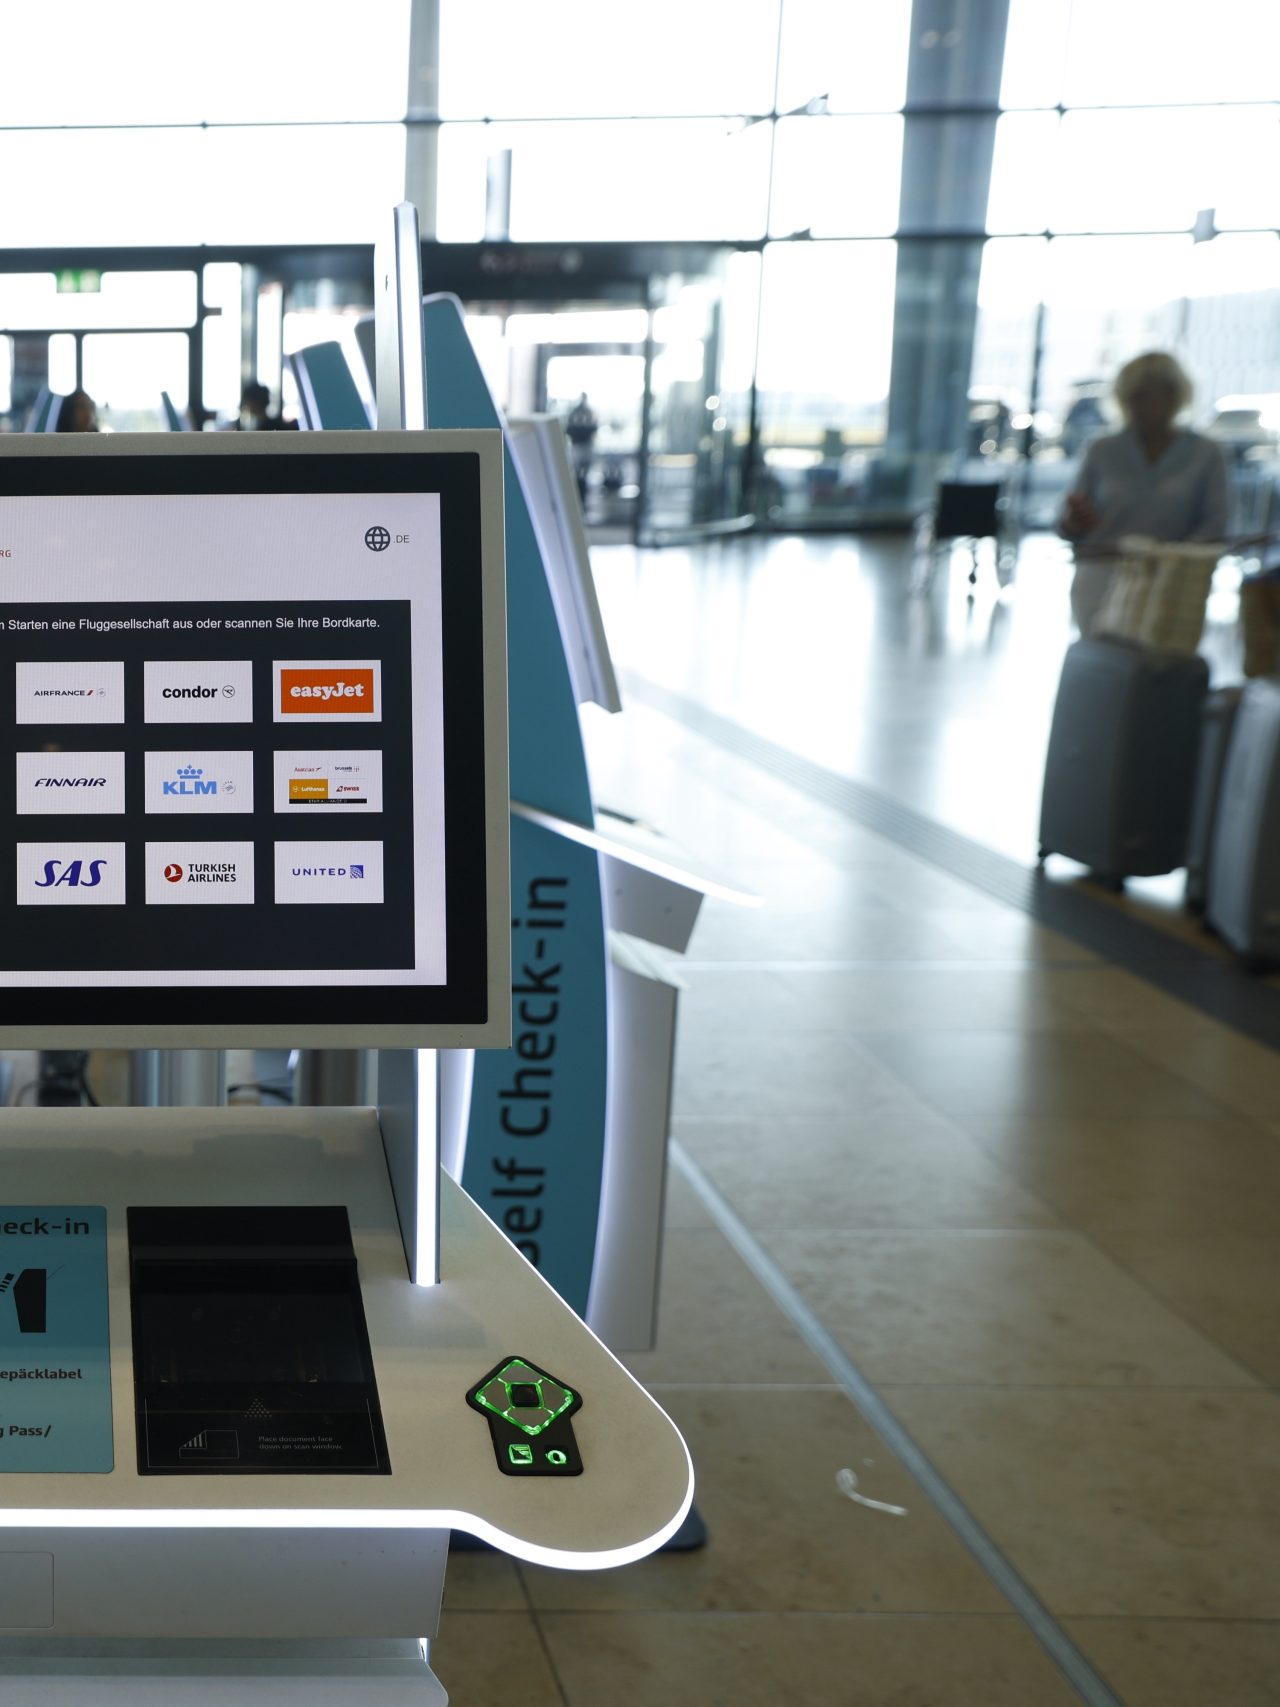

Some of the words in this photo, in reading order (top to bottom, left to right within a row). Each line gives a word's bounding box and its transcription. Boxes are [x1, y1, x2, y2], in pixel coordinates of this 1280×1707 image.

[8, 618, 49, 630] Starten
[52, 619, 76, 630] eine
[79, 617, 170, 632] Fluggesellschaft
[173, 619, 192, 629] aus
[196, 618, 221, 629] oder
[225, 617, 273, 629] scannen
[276, 617, 294, 629] Sie
[297, 617, 319, 628] Ihre
[322, 616, 380, 628] Bordkarte.
[162, 685, 218, 699] condor
[290, 682, 365, 700] easyJet
[34, 777, 107, 788] FINNAIR
[163, 781, 217, 795] KLM
[34, 859, 108, 888] SAS
[188, 863, 236, 873] TURKISH
[292, 867, 347, 876] UNITED
[187, 873, 237, 883] AIRLINES
[498, 877, 569, 1137] Check-in
[9, 1425, 52, 1438] Pass/
